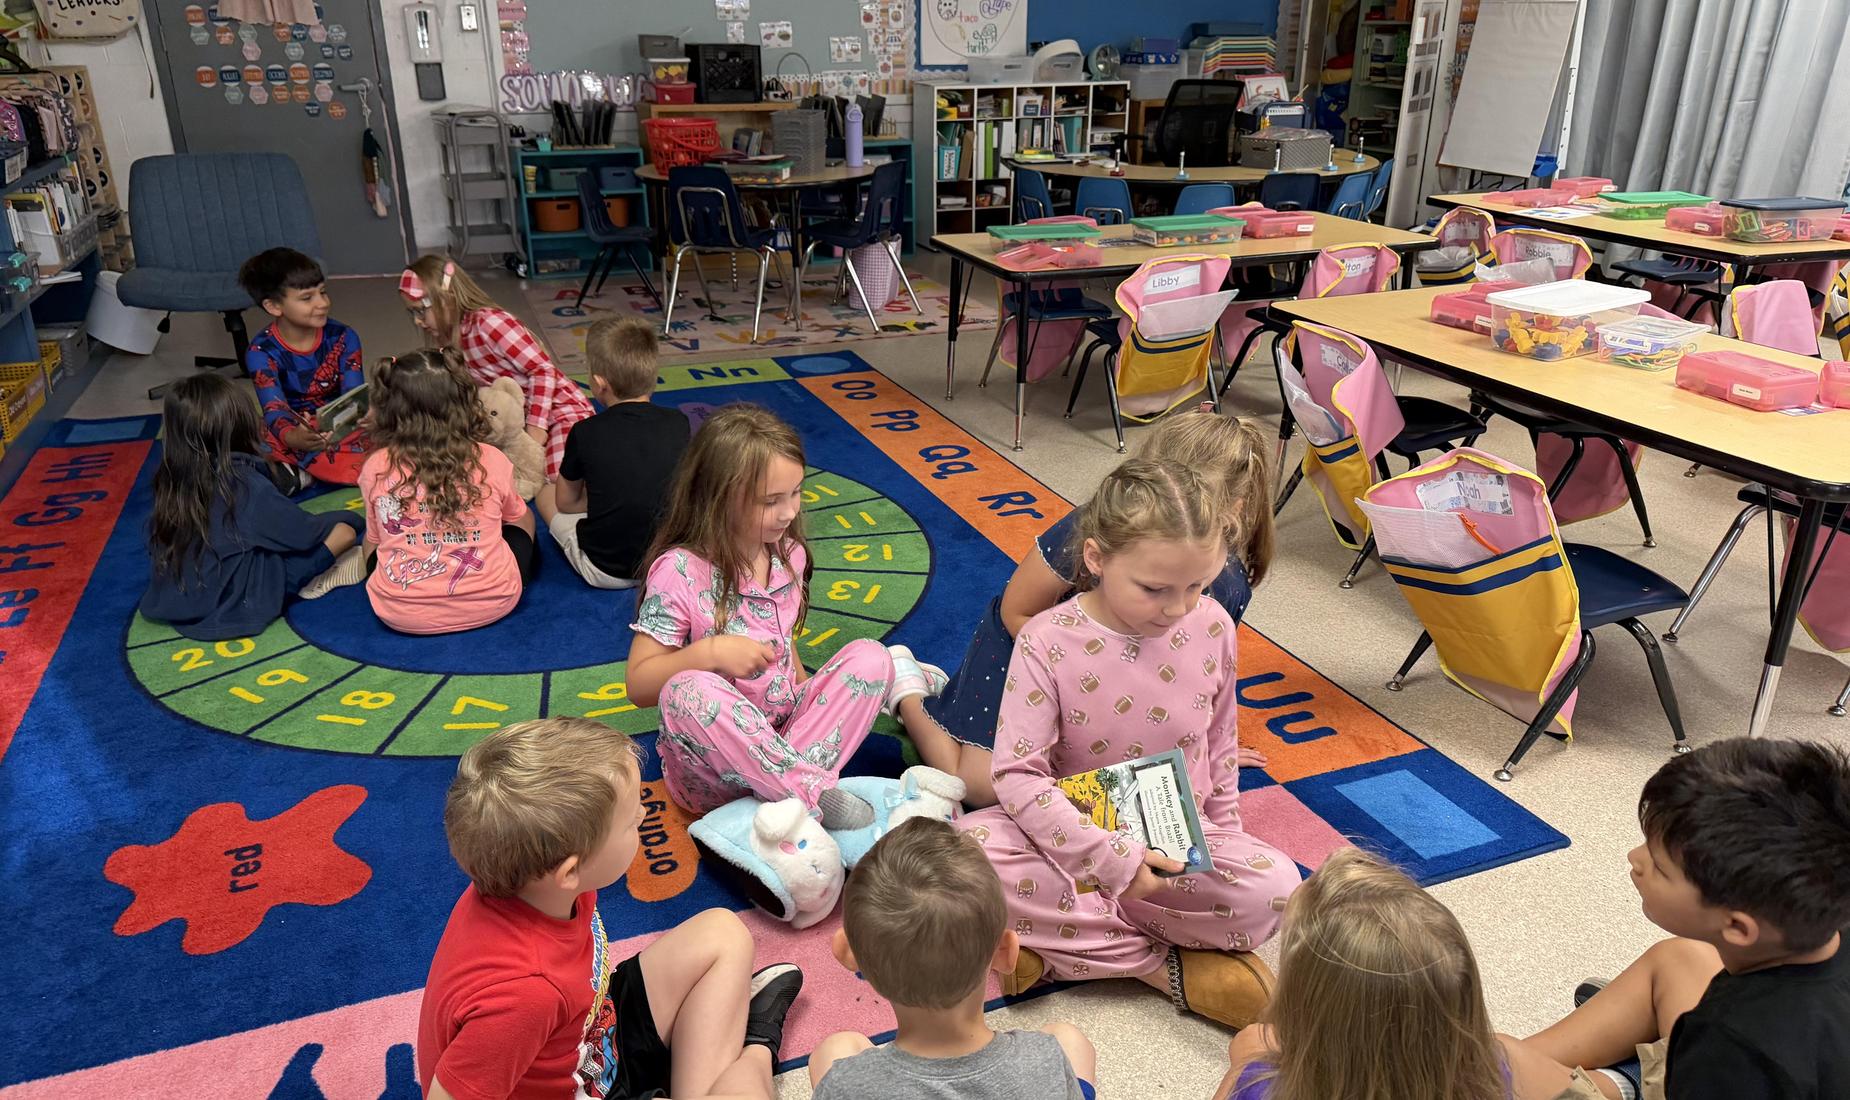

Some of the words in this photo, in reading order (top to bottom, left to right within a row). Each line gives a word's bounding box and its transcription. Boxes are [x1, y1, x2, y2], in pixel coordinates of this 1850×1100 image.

[1152, 274, 1180, 289] Libby
[687, 366, 760, 381] Nn
[831, 380, 878, 401] Oo
[870, 410, 921, 432] Pp
[40, 452, 115, 484] Hh
[918, 444, 980, 480] Qq
[1457, 480, 1482, 501] Noah
[12, 489, 109, 528] Gg
[834, 511, 877, 529] 11
[977, 491, 1046, 521] Rr
[843, 543, 893, 562] 12
[826, 579, 882, 604] 13
[171, 637, 256, 672] 20
[228, 668, 309, 704] 19
[316, 689, 396, 726] 18
[442, 696, 509, 730] 17
[576, 682, 640, 719] 16
[1235, 671, 1338, 745] Uu
[1157, 793, 1165, 806] Tale
[1160, 775, 1174, 810] Monkey
[1160, 807, 1169, 823] from
[1169, 808, 1178, 823] and
[1164, 824, 1175, 844] Brazil
[1172, 823, 1186, 851] Rabbit
[227, 842, 264, 894] red
